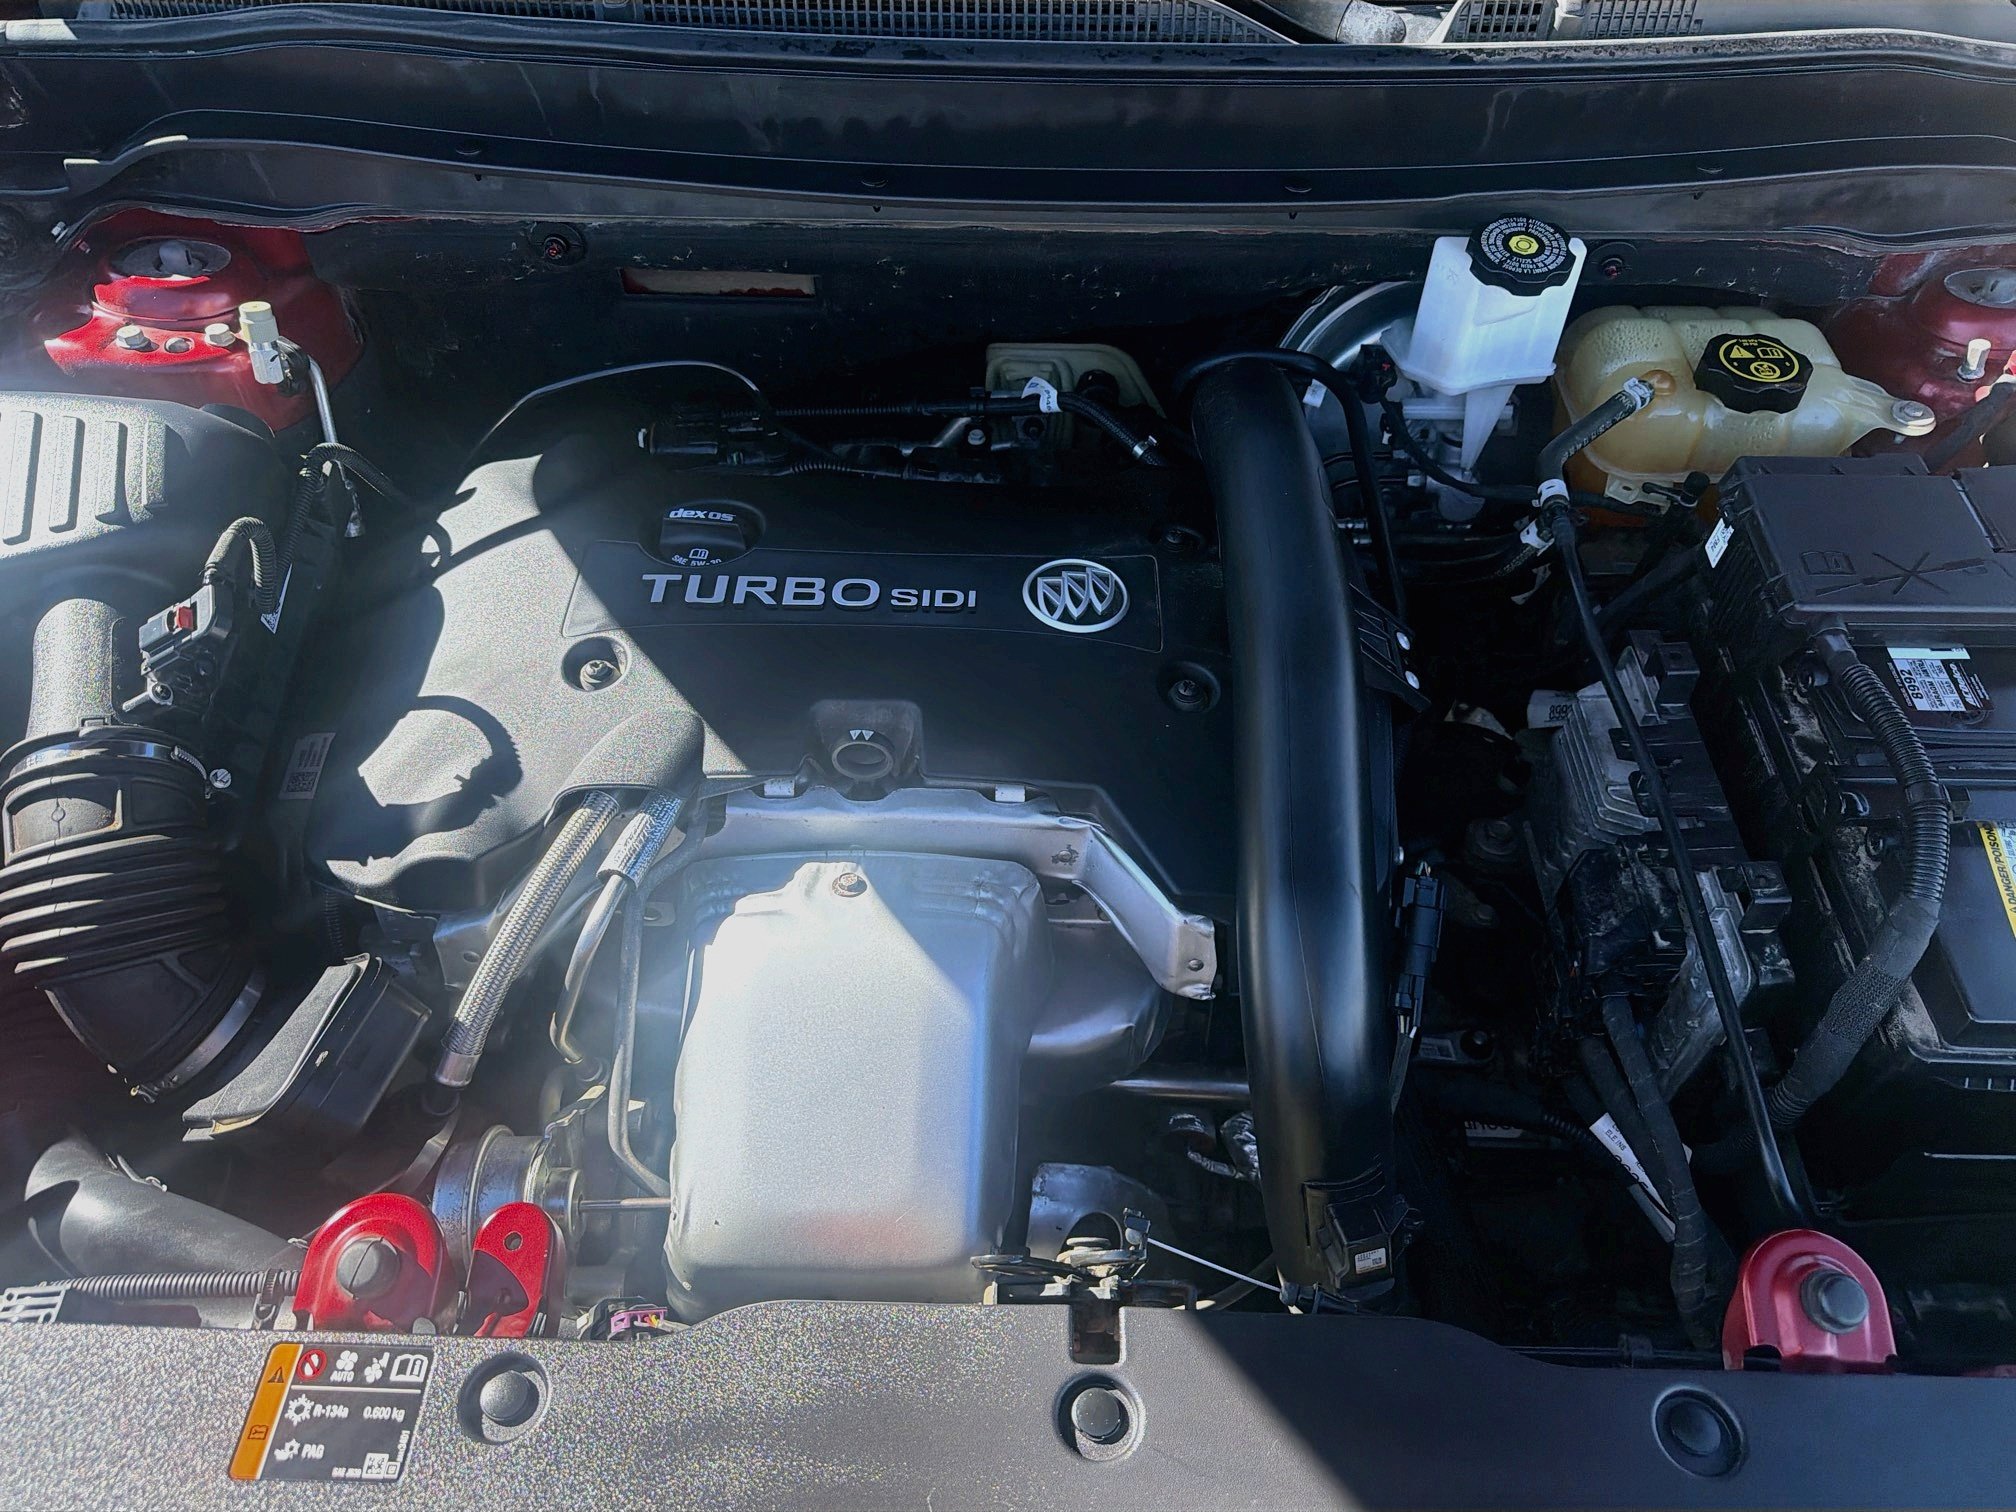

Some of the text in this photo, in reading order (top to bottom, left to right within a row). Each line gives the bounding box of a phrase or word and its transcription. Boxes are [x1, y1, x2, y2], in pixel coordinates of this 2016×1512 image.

[641, 573, 977, 608] TURBO SIDI
[1900, 668, 1924, 700] 8992
[329, 1370, 355, 1383] AUTO
[312, 1405, 406, 1423] R-134a 0.600 kg
[301, 1443, 325, 1460] PAG
